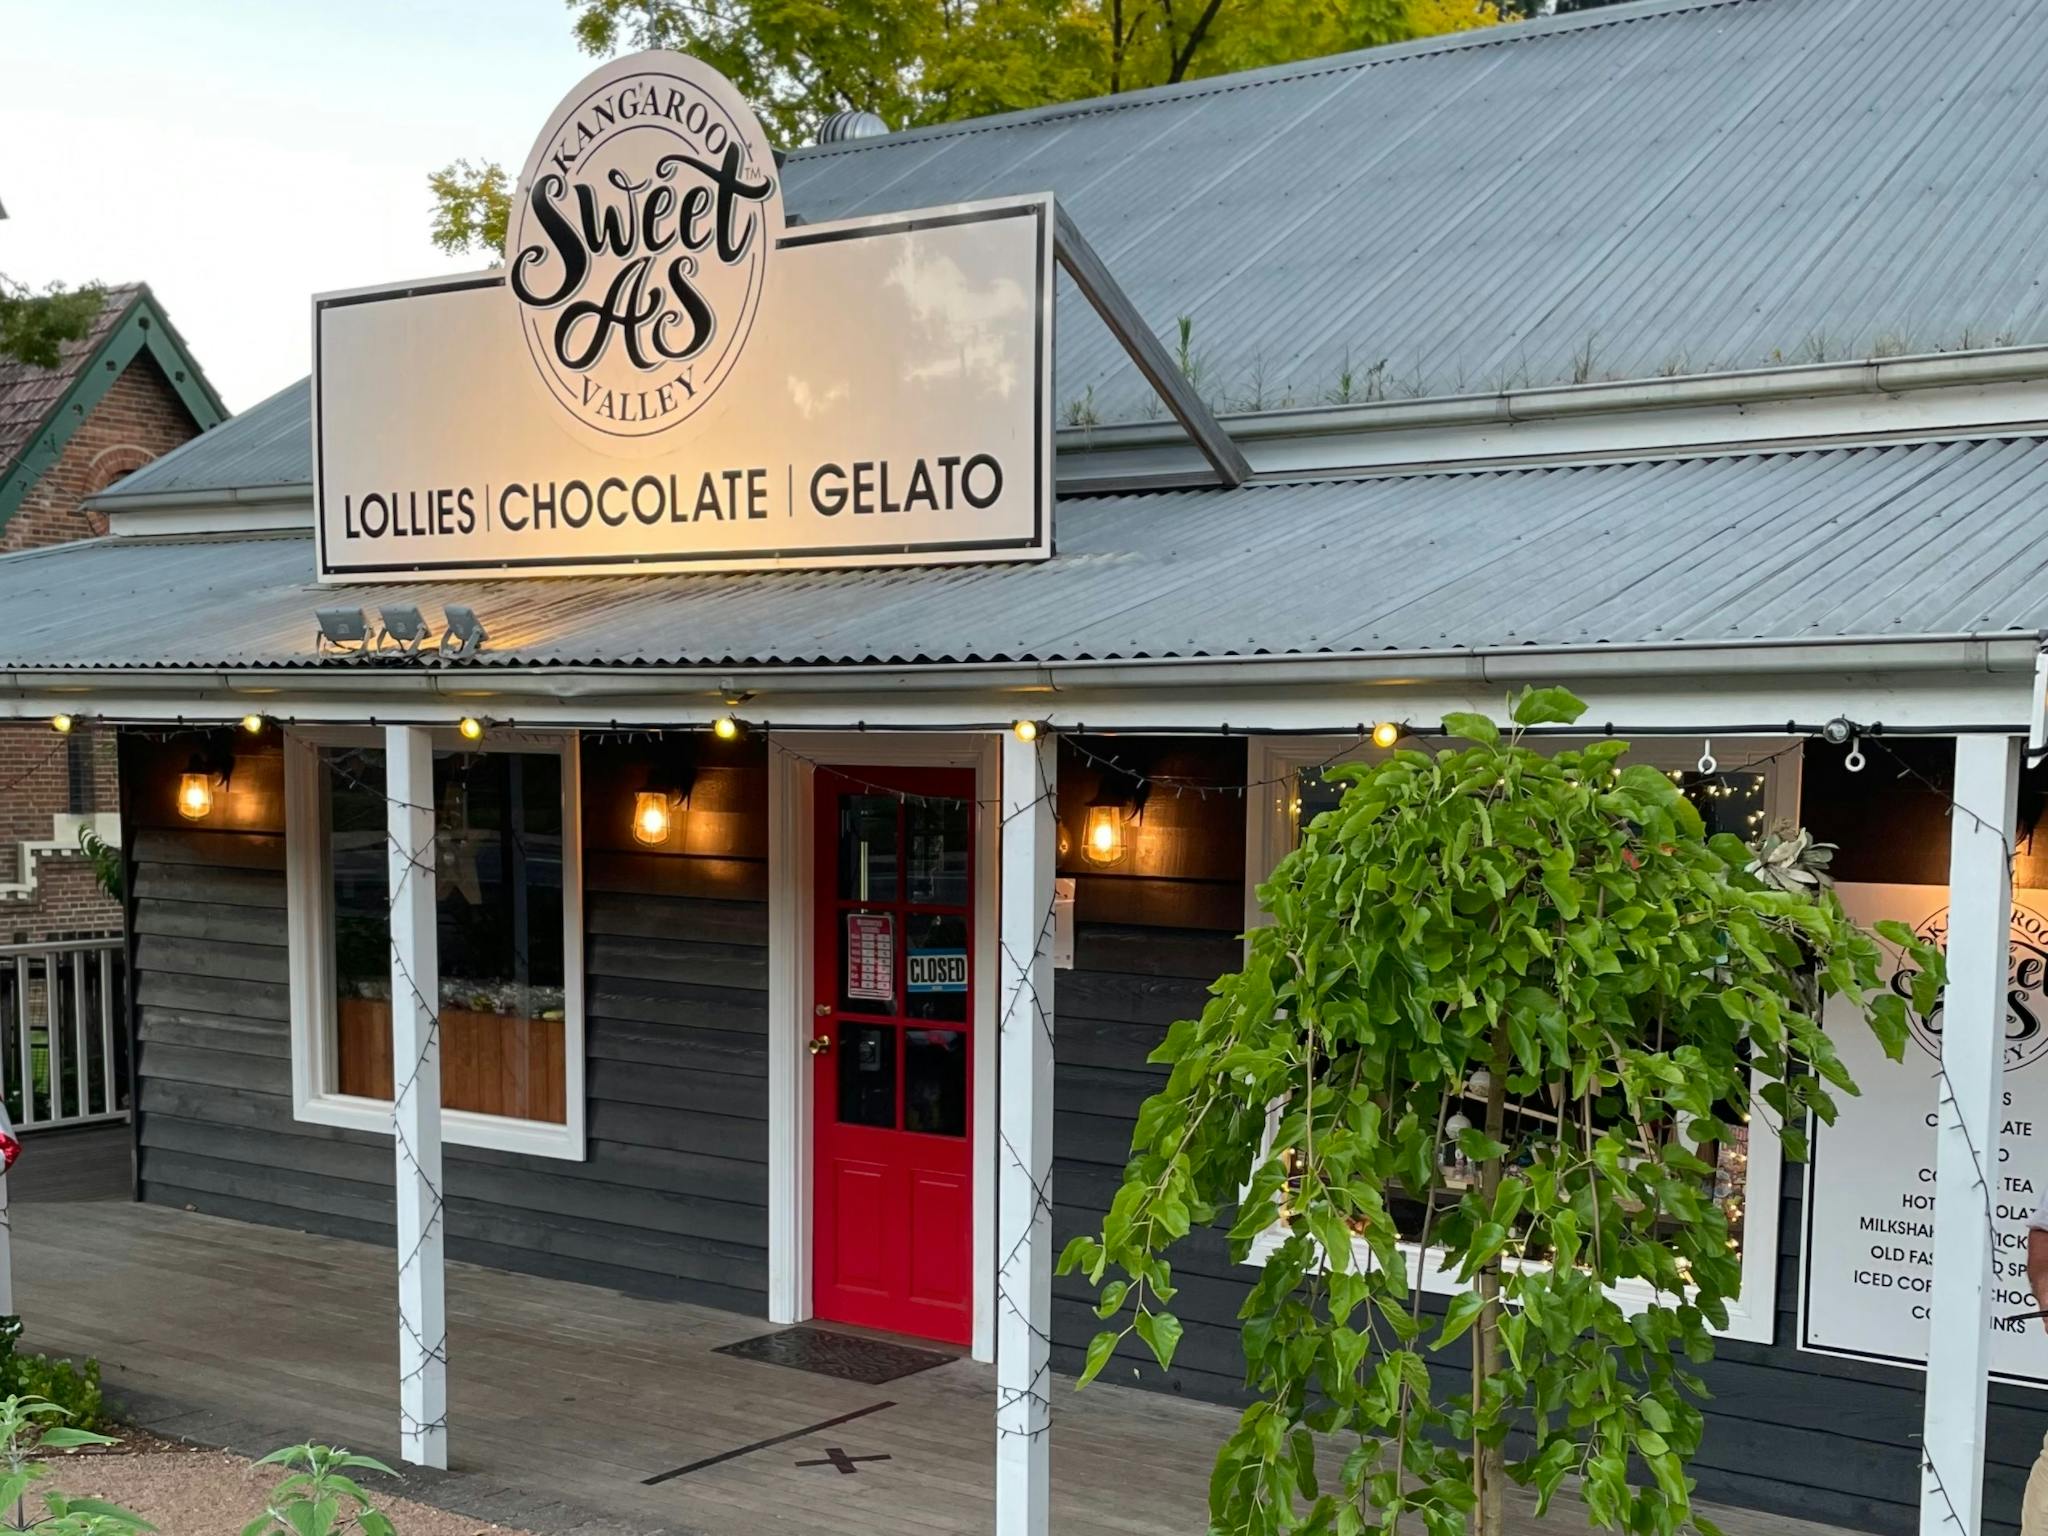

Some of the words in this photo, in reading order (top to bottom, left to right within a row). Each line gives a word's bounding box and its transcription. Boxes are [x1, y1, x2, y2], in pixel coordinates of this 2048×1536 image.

[551, 84, 728, 176] KANGAROO
[744, 167, 762, 180] TM
[511, 141, 774, 308] Sweet
[581, 365, 699, 421] VALLEY
[345, 486, 476, 540] LOLLIES
[499, 468, 769, 533] CHOCOLATE
[809, 453, 1004, 518] GELATO
[910, 957, 965, 983] CLOSED
[2003, 1176, 2034, 1194] TEA
[1902, 1193, 1936, 1211] HOT
[1860, 1216, 1935, 1239] MILKSHA
[1870, 1245, 1906, 1262] OLD
[1854, 1269, 1894, 1288] ICED
